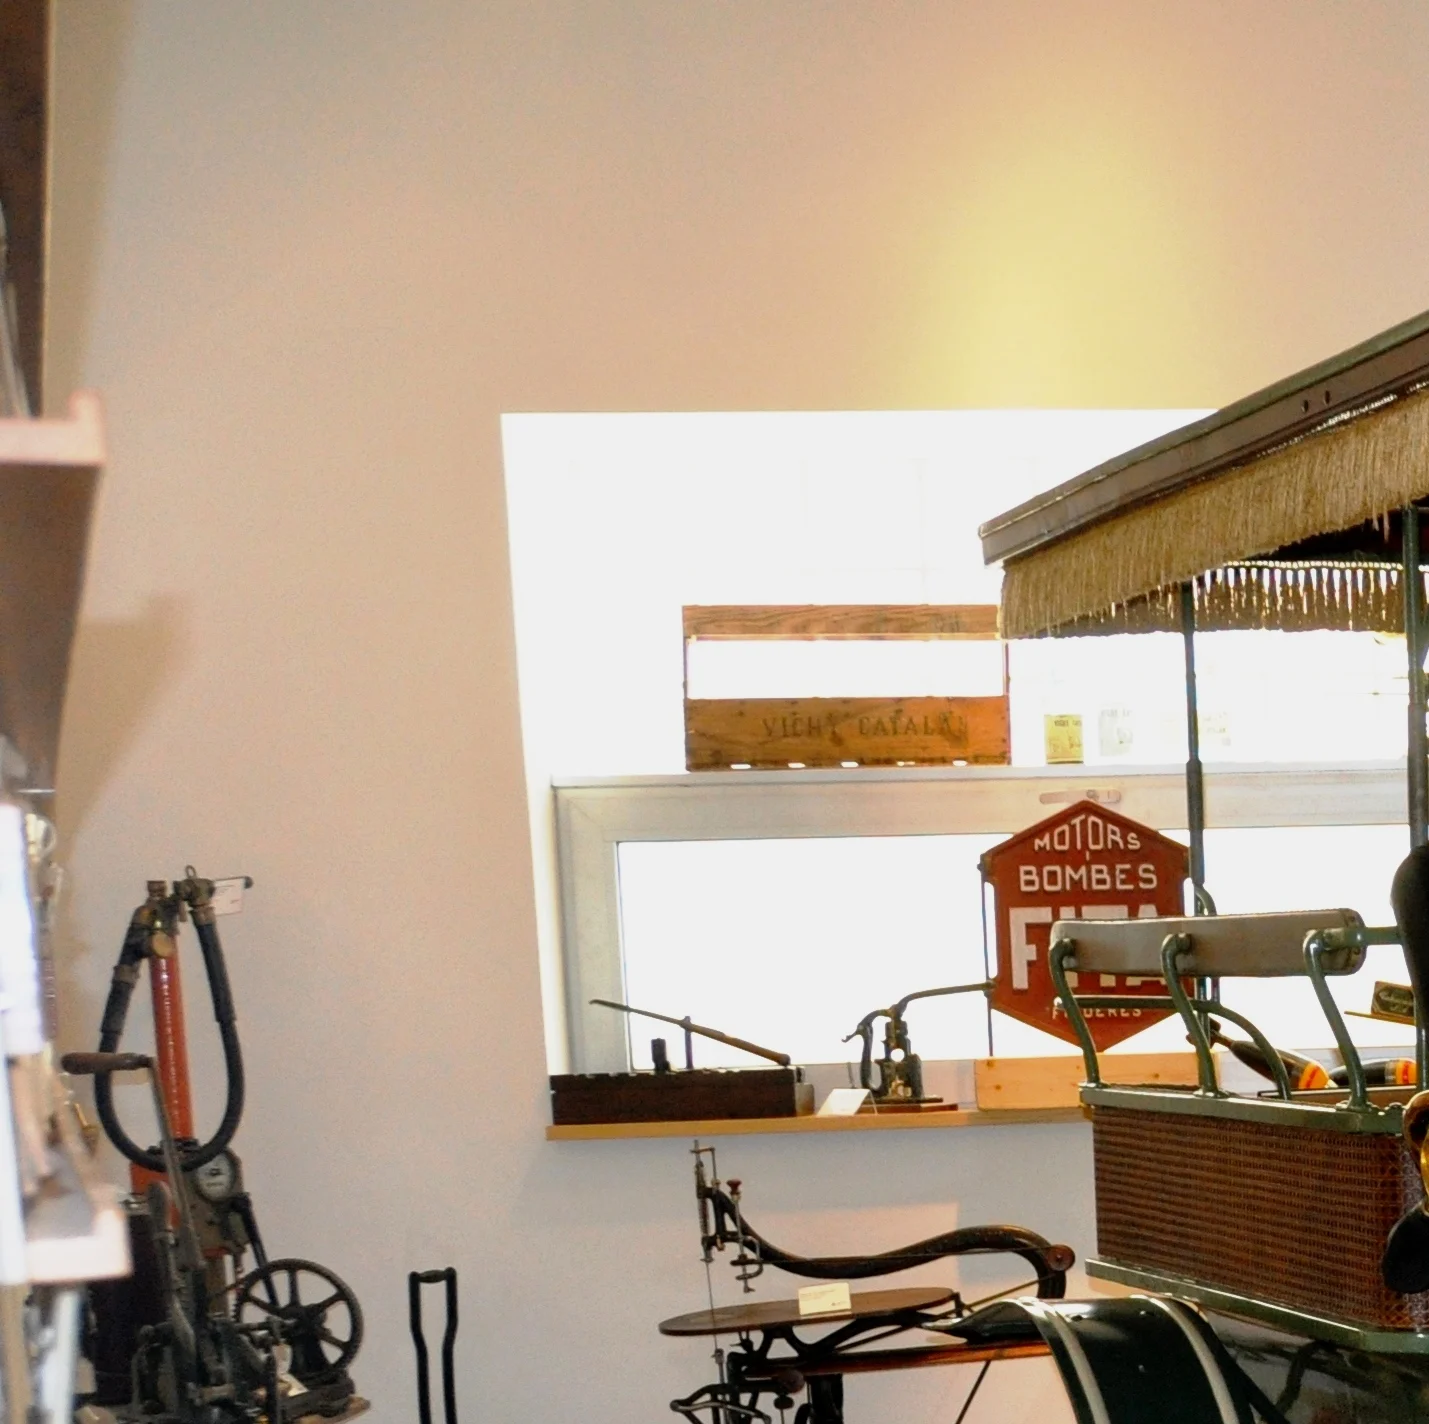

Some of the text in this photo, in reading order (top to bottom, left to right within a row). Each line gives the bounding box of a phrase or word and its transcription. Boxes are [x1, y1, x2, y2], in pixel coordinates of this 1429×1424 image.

[1034, 814, 1141, 851] MOTORS
[1019, 864, 1158, 892] BOMBES
[1008, 904, 1168, 990] FT
